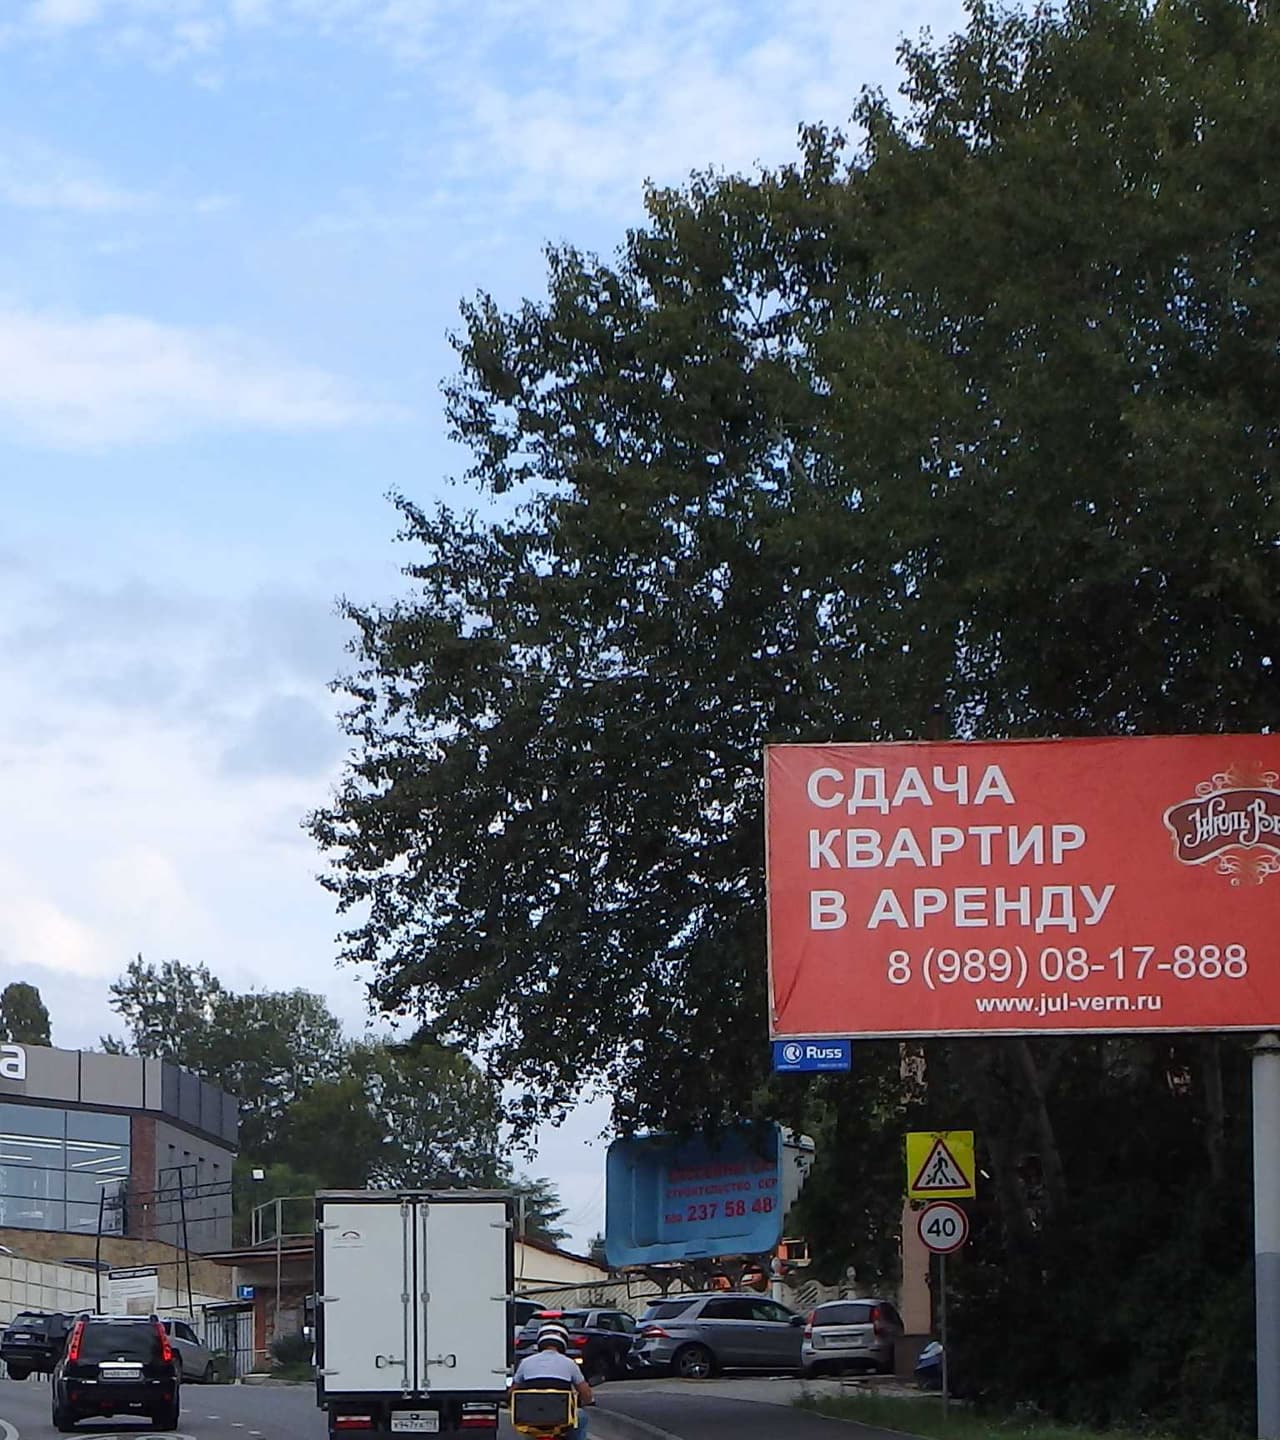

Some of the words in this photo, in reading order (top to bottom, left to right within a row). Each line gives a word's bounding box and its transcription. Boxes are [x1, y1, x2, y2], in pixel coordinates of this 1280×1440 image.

[806, 764, 1015, 815] СДАЧА
[808, 823, 1087, 870] КВАРТИР
[809, 889, 849, 931] В
[867, 884, 1116, 933] АРЕНДУ
[887, 950, 912, 985] 8
[922, 945, 1028, 990] (989)
[1039, 944, 1249, 983] 08-17-888
[975, 992, 1163, 1016] www.jul-vern.ru
[806, 1046, 842, 1059] Russ
[687, 1203, 718, 1222] 237
[725, 1200, 746, 1217] 58
[927, 1218, 956, 1237] 40
